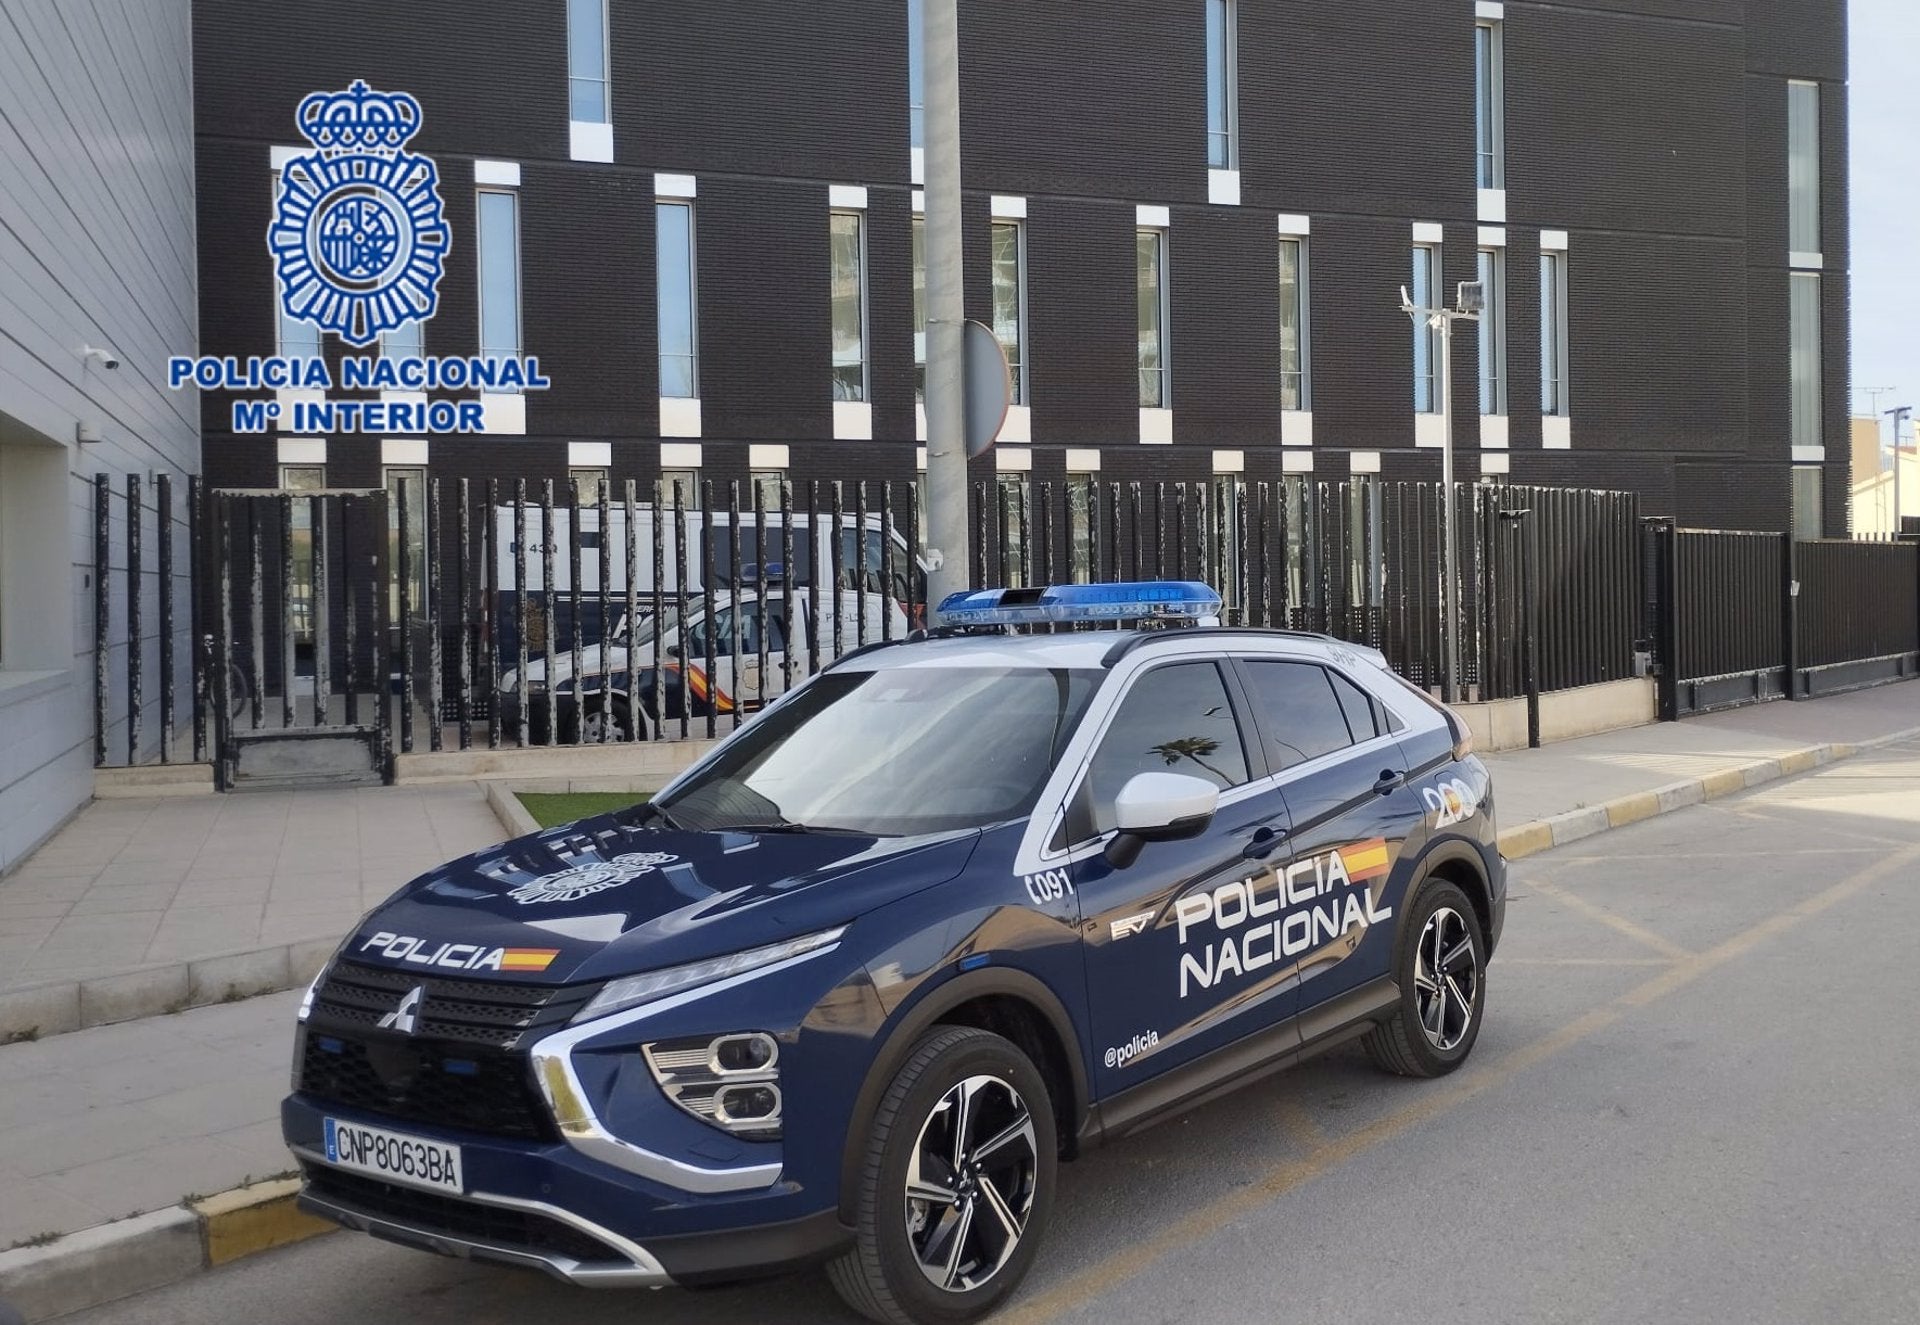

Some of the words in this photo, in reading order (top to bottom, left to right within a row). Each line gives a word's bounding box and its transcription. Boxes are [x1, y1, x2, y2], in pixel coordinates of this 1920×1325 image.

[1180, 888, 1393, 998] NACIONAL
[1104, 1029, 1160, 1068] @policia
[337, 1127, 457, 1186] CNP8063BA
